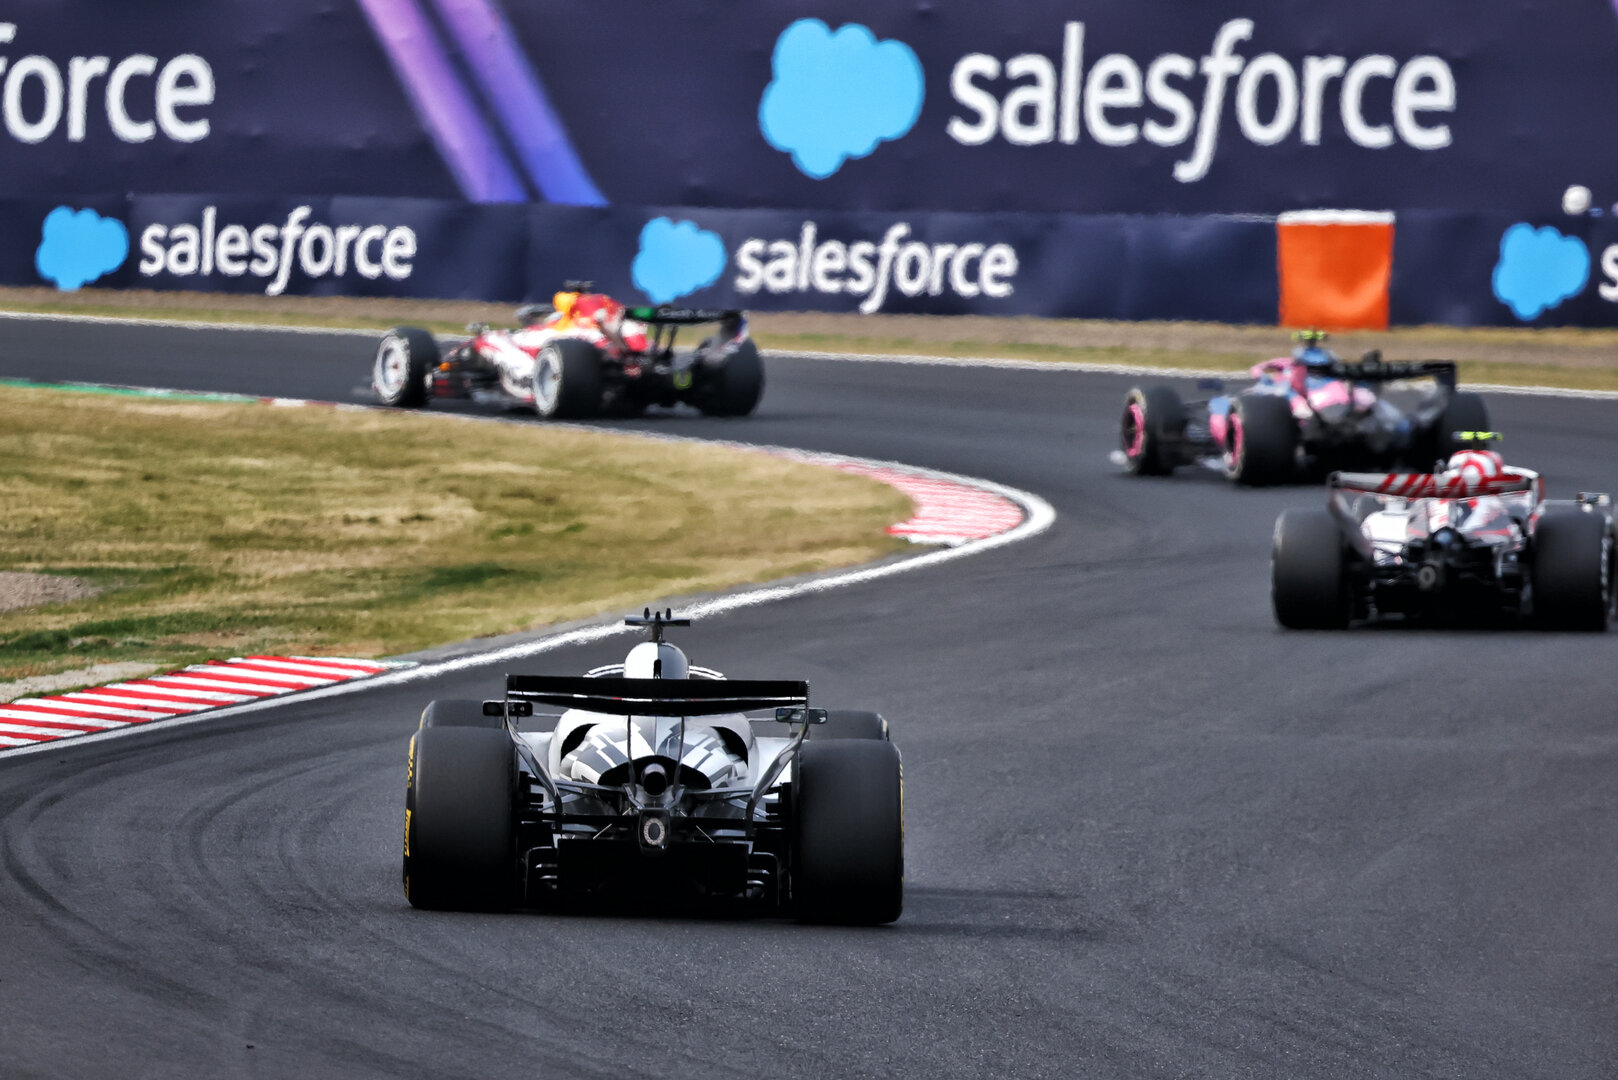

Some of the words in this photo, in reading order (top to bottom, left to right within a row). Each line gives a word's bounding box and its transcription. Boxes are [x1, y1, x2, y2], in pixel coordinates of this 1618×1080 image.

[947, 18, 1456, 183] salesforce
[139, 205, 417, 296] salesforce
[735, 221, 1018, 314] salesforce
